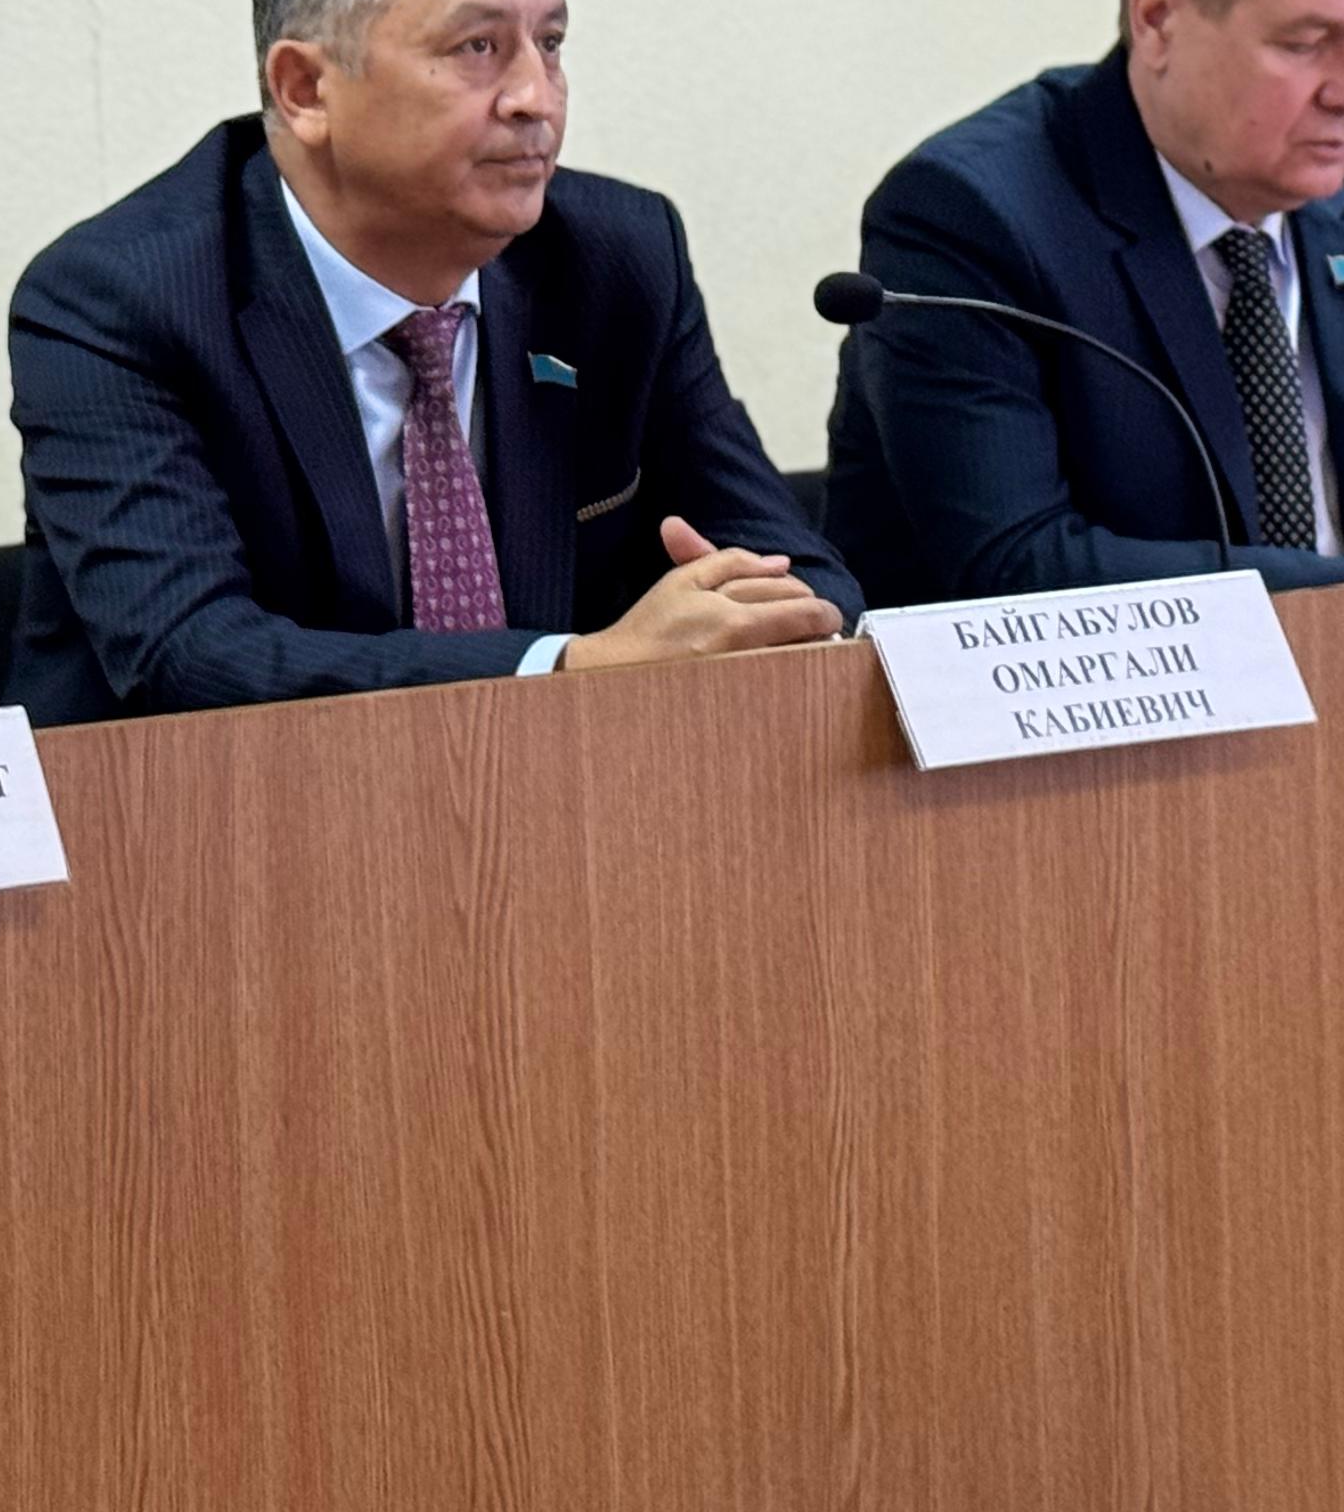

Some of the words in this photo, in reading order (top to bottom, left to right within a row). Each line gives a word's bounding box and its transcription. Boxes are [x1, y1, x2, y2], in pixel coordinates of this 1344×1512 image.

[951, 596, 1201, 651] БАЙГАБУЛОВ
[991, 643, 1199, 694] ОМАРГАЛИ
[1010, 689, 1216, 741] КАБИЕВИЧ
